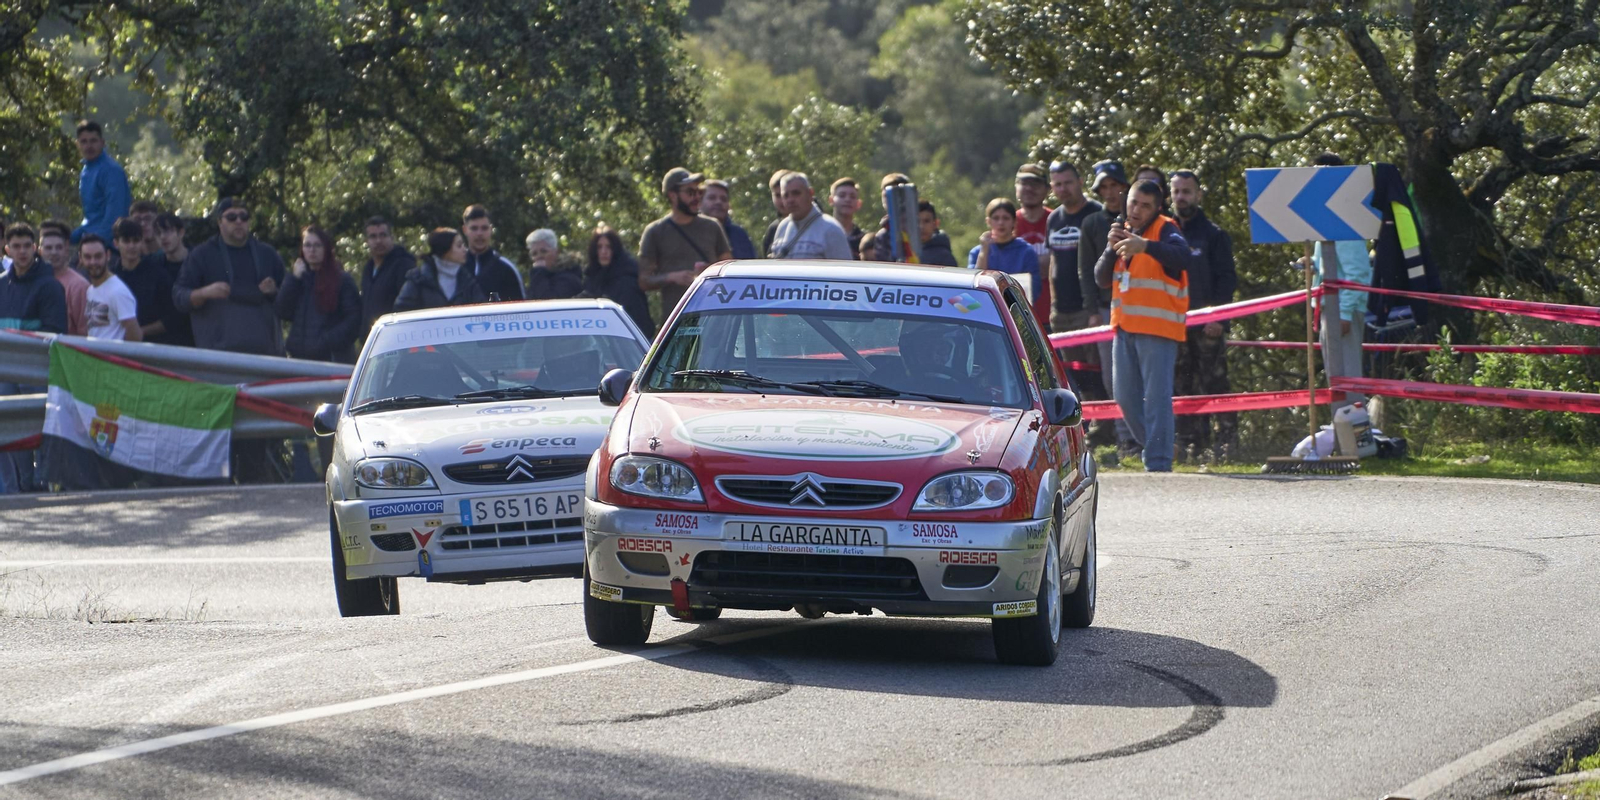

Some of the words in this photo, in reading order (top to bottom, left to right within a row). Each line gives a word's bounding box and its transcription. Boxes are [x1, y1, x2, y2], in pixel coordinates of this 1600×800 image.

[738, 283, 858, 302] Aluminios
[864, 286, 943, 308] Valero
[494, 319, 608, 333] BAQUERIZO
[396, 327, 464, 344] DENTAL
[758, 397, 943, 413] GARGANTA
[491, 436, 577, 450] enpeca
[812, 437, 920, 452] mantenimiento
[369, 501, 443, 517] TECNOMOTOR
[475, 501, 488, 521] S
[494, 497, 548, 520] 6516
[555, 494, 579, 515] AP
[655, 513, 699, 529] SAMOSA
[912, 523, 959, 538] SAMOSA
[617, 537, 673, 552] ROESCA
[742, 543, 763, 551] Hotel
[767, 544, 814, 553] Restaurante
[815, 546, 840, 554] Turismo
[842, 547, 865, 555] Activo
[939, 551, 998, 565] ROESCA
[995, 602, 1018, 611] ARIDOS
